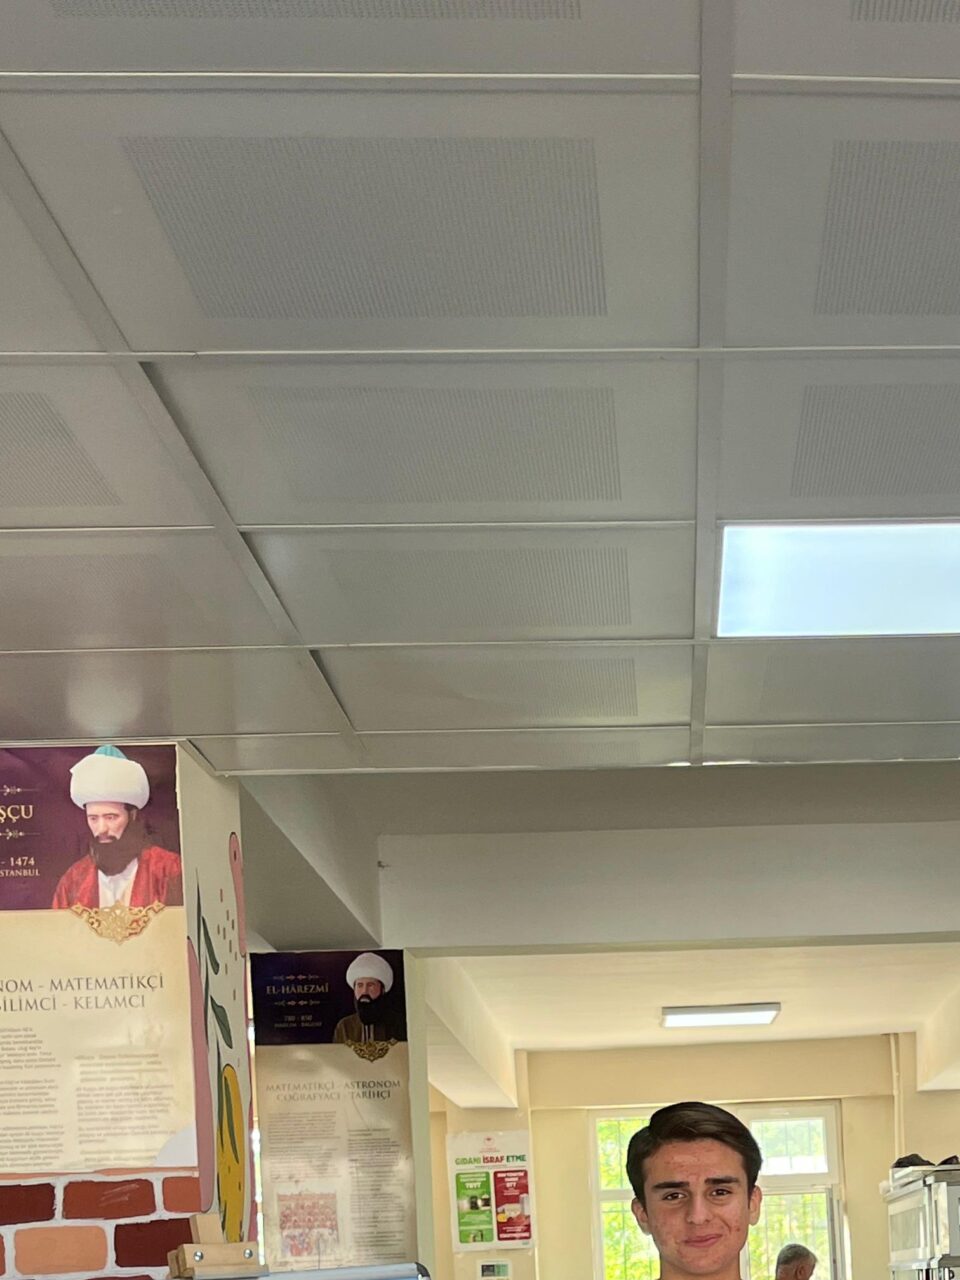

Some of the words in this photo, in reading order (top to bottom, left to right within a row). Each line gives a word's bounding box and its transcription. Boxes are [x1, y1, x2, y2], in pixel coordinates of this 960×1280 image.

[10, 857, 36, 866] 1474
[50, 974, 164, 992] MATEMATİKÇİ
[0, 996, 56, 1012] İLİMCİ
[74, 994, 146, 1010] KELAMCI
[482, 1155, 504, 1164] İSRAF
[506, 1154, 527, 1163] ETME
